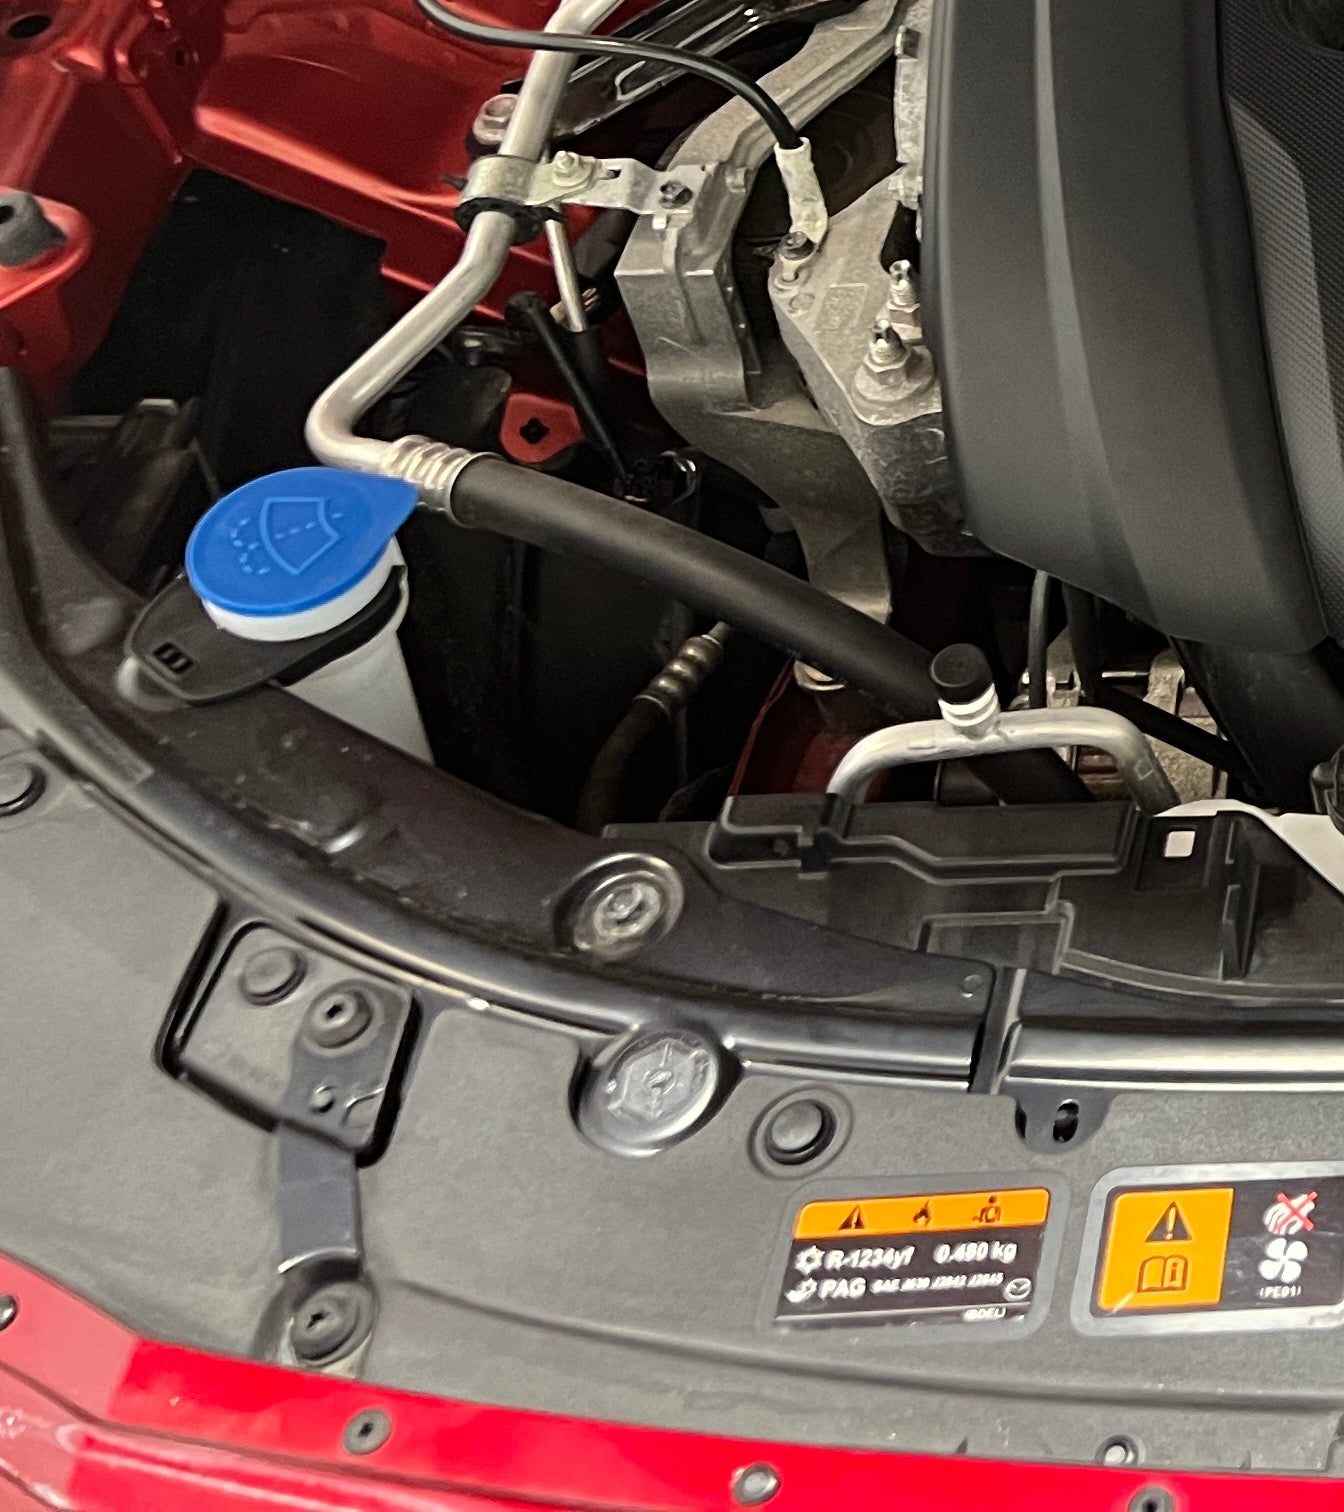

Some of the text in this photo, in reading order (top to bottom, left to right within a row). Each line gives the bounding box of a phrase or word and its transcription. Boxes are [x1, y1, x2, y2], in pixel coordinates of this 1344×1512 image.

[825, 1245, 916, 1271] R-1234yf
[990, 1240, 1018, 1264] kg
[818, 1277, 867, 1300] PAG
